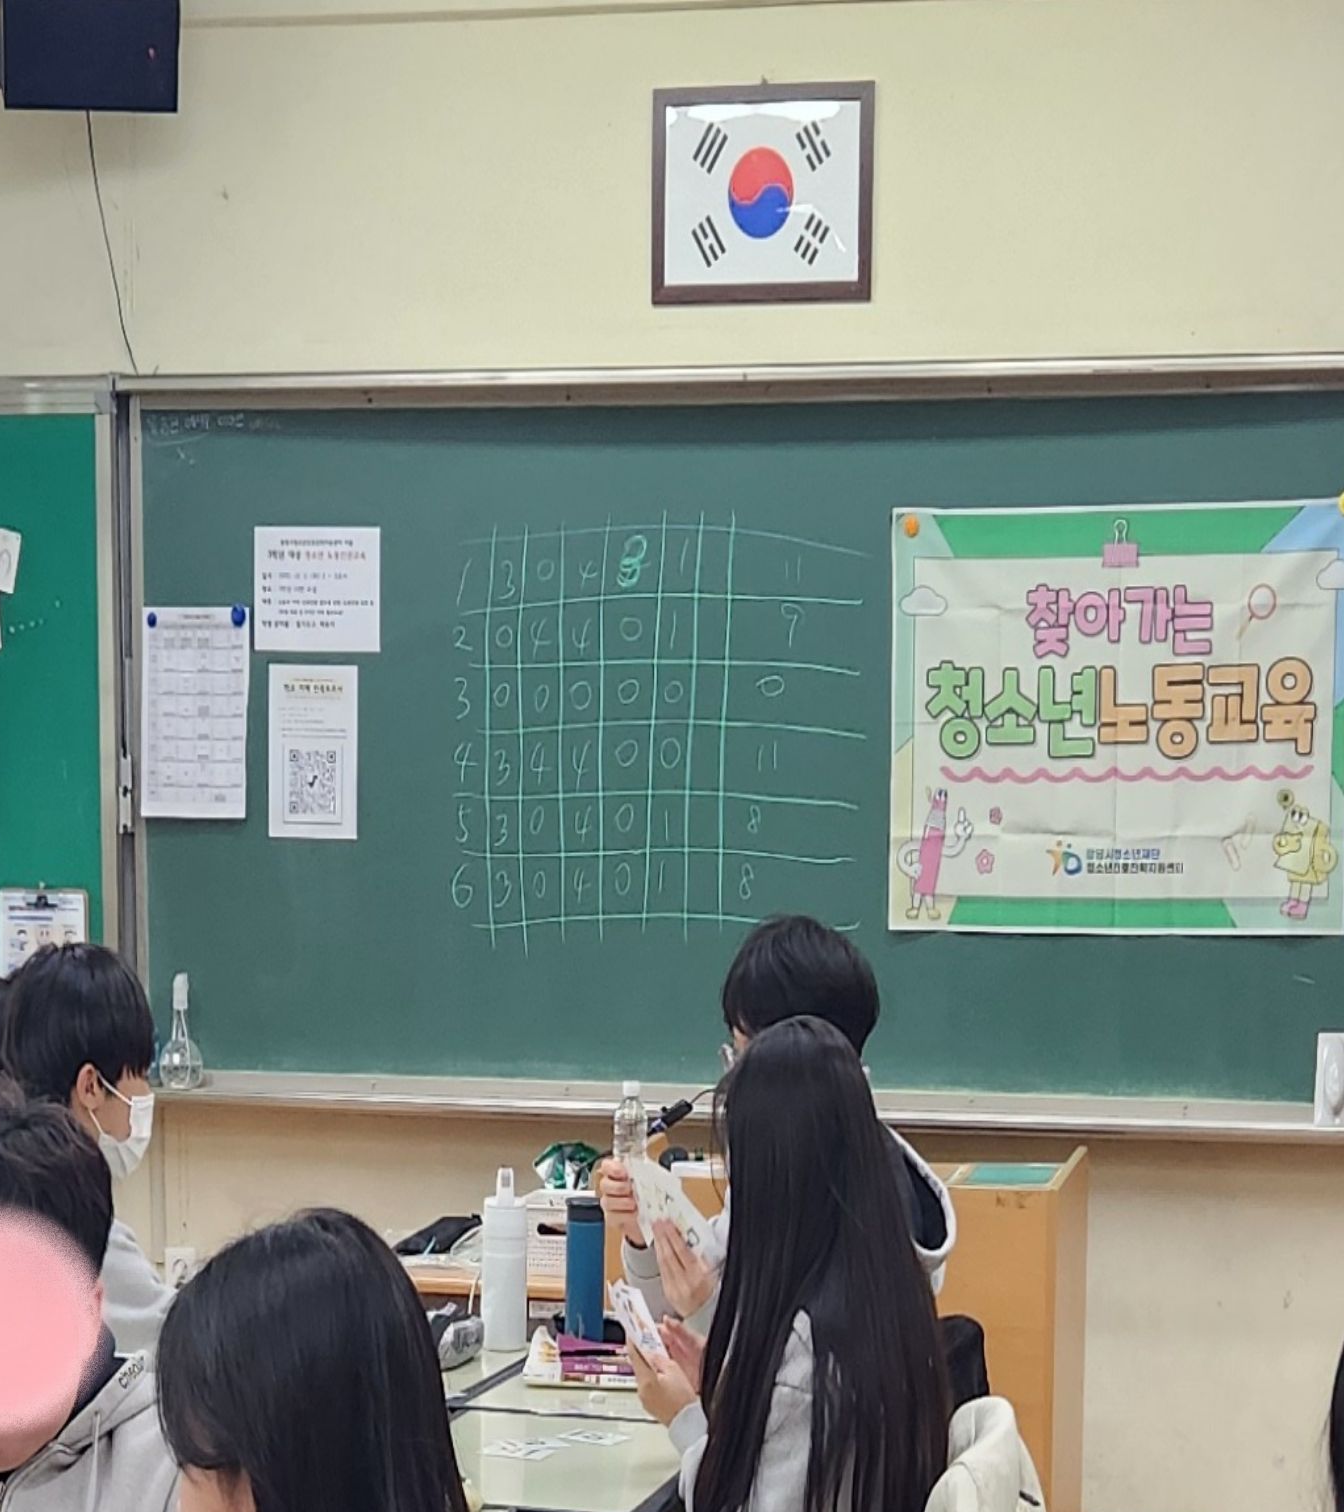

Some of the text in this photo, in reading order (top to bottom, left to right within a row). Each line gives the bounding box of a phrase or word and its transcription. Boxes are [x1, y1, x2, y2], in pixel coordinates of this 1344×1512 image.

[498, 561, 514, 599] 3
[537, 558, 554, 580] 0
[578, 560, 597, 586] 4
[455, 627, 472, 650] 2
[496, 626, 513, 647] 0
[530, 618, 551, 657] 4
[572, 616, 591, 655] 4
[620, 617, 643, 641] 0
[1025, 583, 1213, 657] 찾아가는
[454, 678, 471, 719] 3
[494, 683, 510, 705] 0
[536, 684, 549, 710] 0
[570, 681, 592, 710] 0
[618, 679, 640, 703] 0
[665, 680, 683, 703] 0
[925, 656, 1316, 760] 청소년노동교육
[454, 742, 478, 784] 4
[496, 751, 511, 785] 3
[530, 743, 551, 776] 4
[572, 742, 591, 786] 4
[616, 740, 638, 767] 0
[661, 738, 681, 769] 0
[455, 806, 472, 843] 5
[495, 814, 508, 846] 3
[530, 807, 544, 833] 0
[574, 806, 592, 840] 4
[616, 803, 635, 832] 0
[747, 806, 761, 832] 8
[452, 863, 473, 908] 6
[495, 871, 513, 907] 3
[533, 870, 546, 896] 0
[574, 868, 591, 896] 4
[615, 865, 631, 895] 0
[739, 864, 755, 899] 8
